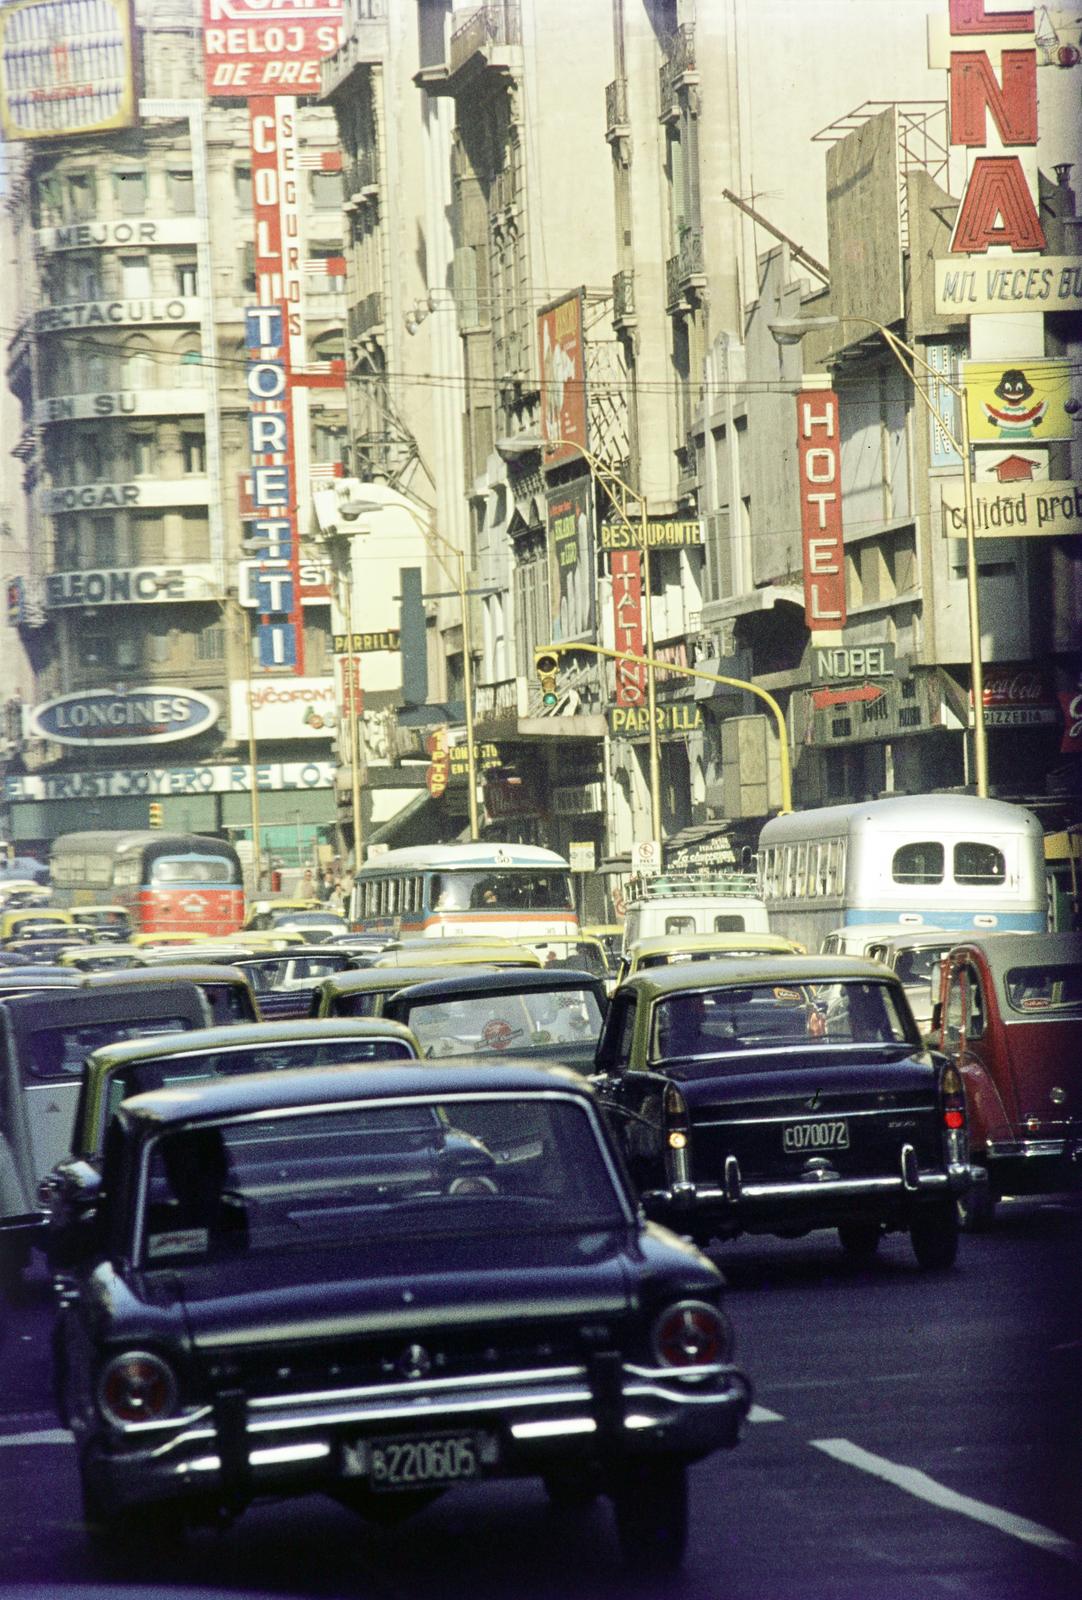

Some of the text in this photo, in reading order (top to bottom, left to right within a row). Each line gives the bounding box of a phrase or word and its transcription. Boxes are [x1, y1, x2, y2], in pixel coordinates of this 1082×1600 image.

[205, 26, 304, 54] RELOJ
[212, 60, 321, 86] DE PRE
[56, 222, 156, 246] MEJOR
[281, 114, 302, 336] SEGUROS
[986, 267, 1055, 301] VECES
[93, 393, 136, 415] SU
[246, 309, 293, 664] TORETTI
[803, 402, 842, 619] HOTEL
[601, 522, 700, 548] RESTAURANTE
[616, 554, 641, 702] ITALIANO
[817, 647, 895, 678] NOBEL
[56, 697, 190, 729] LONGINES
[118, 767, 214, 797] JOYERO
[785, 1121, 847, 1147] C070072
